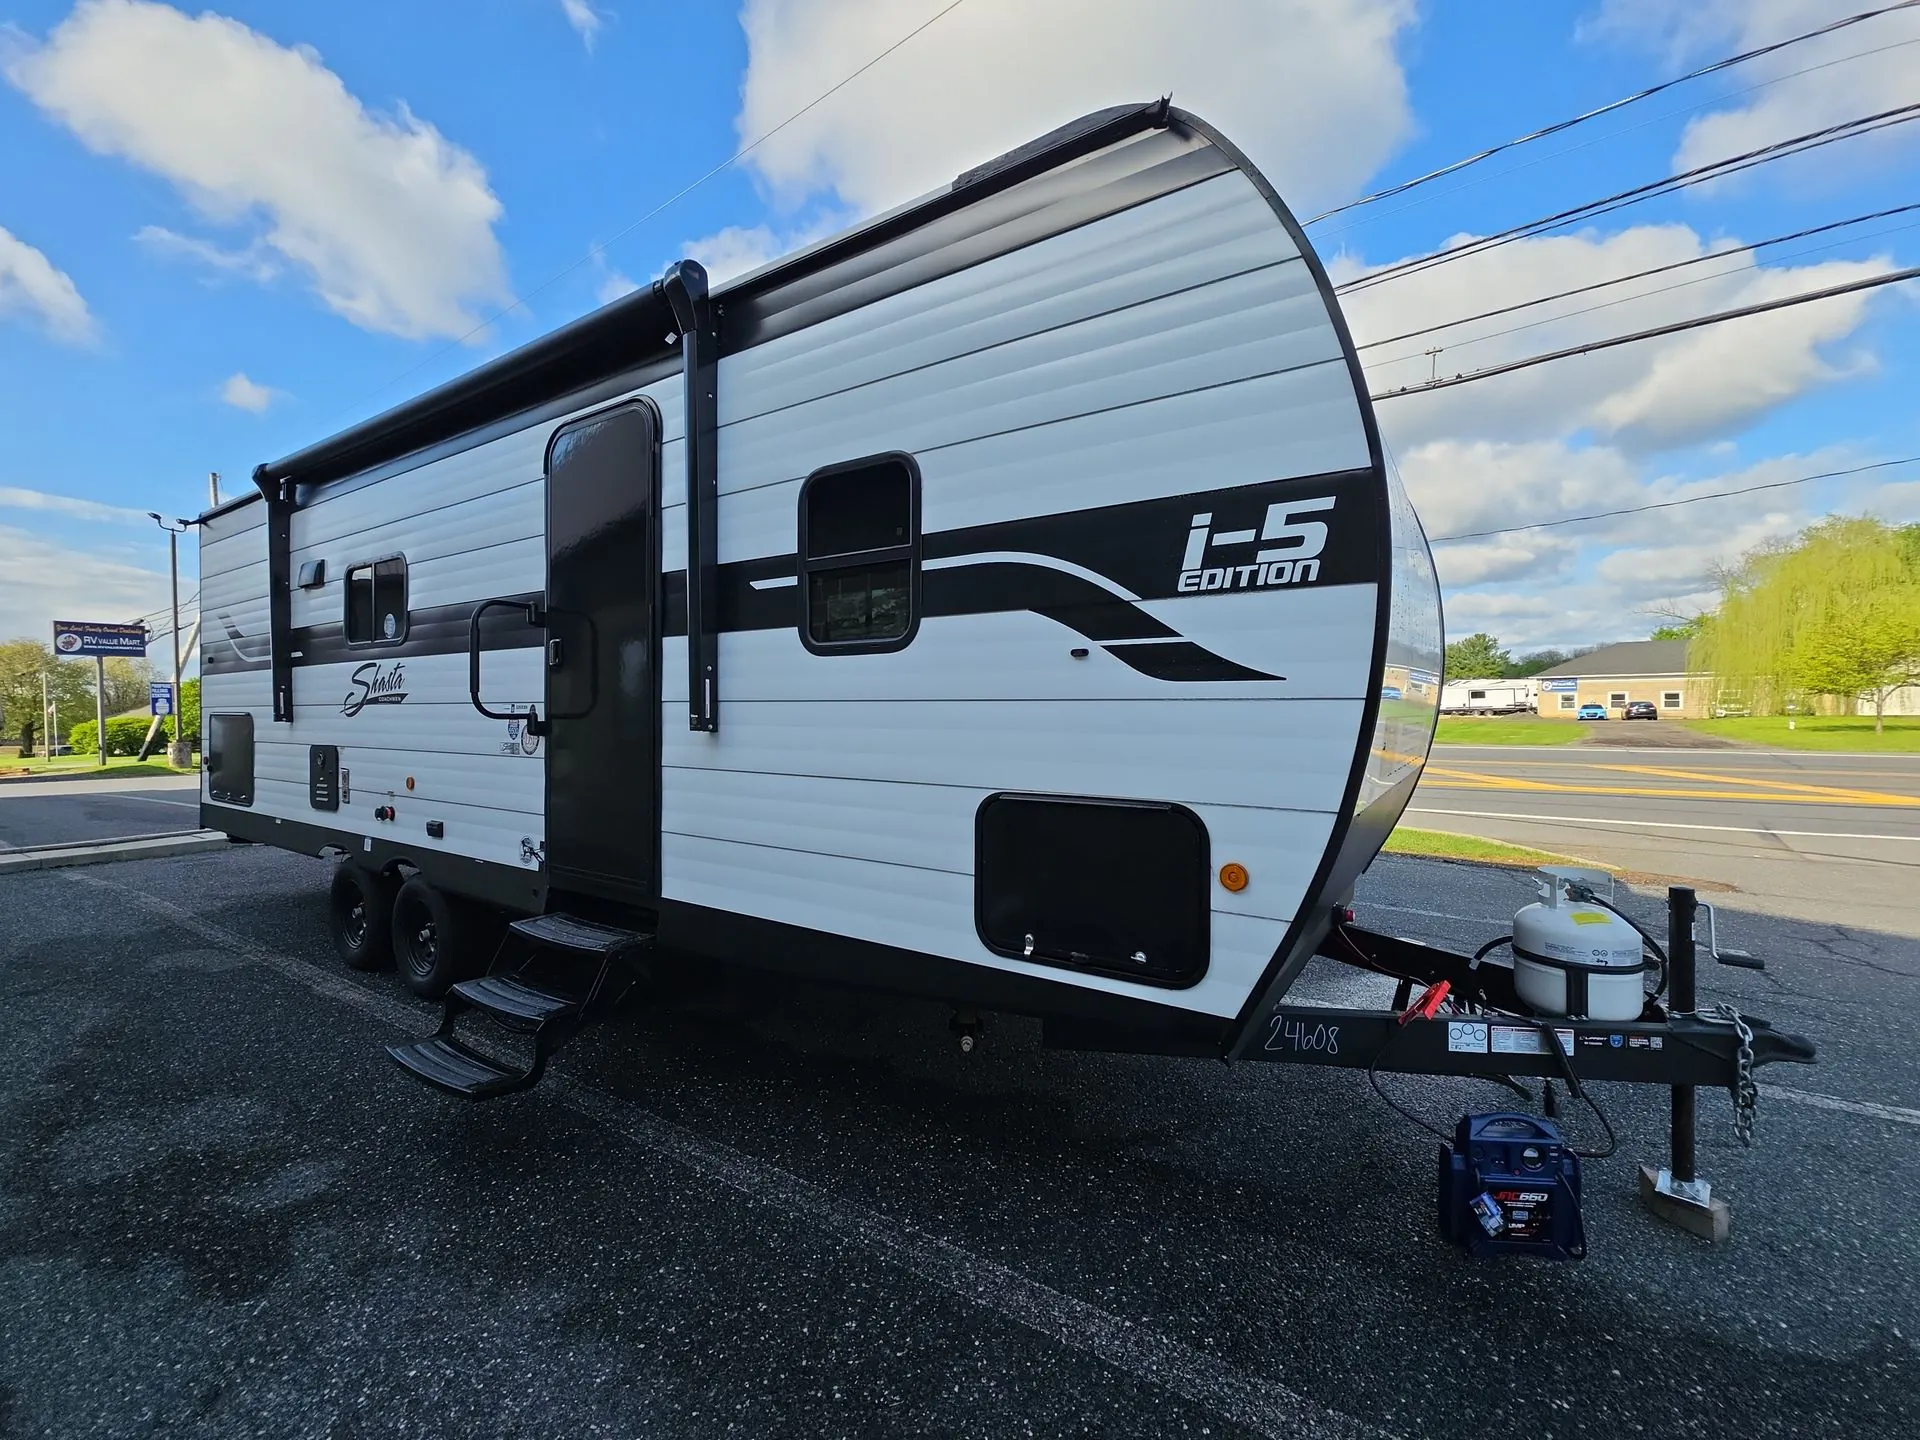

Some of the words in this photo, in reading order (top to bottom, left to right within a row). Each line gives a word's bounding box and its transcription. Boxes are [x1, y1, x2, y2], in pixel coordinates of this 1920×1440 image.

[1182, 496, 1336, 571] i-5
[1177, 559, 1320, 593] EDITION
[83, 636, 98, 645] RV
[340, 662, 406, 718] Shasta
[1265, 1015, 1340, 1055] 24608
